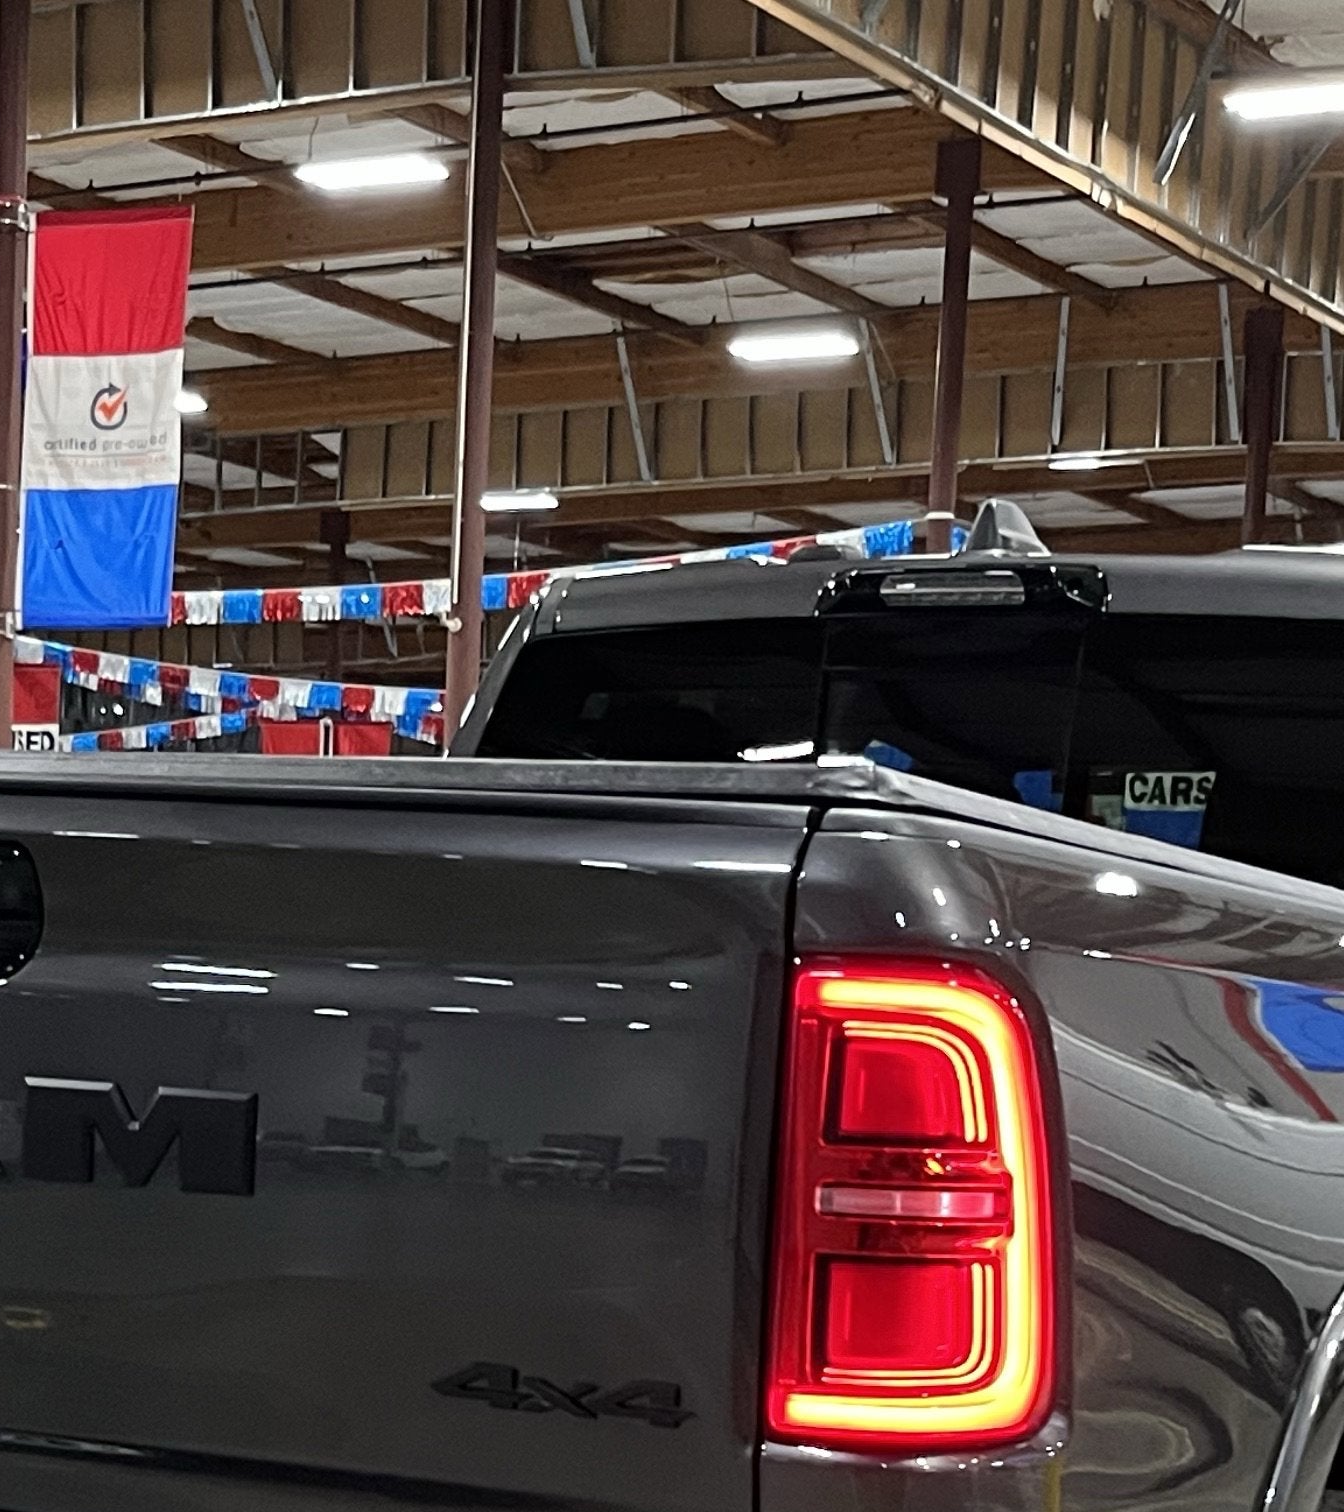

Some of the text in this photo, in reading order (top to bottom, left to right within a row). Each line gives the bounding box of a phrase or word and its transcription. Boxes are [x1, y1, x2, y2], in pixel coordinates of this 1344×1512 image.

[102, 432, 167, 452] pre-owed
[11, 730, 55, 750] SED
[1129, 774, 1212, 805] CARS
